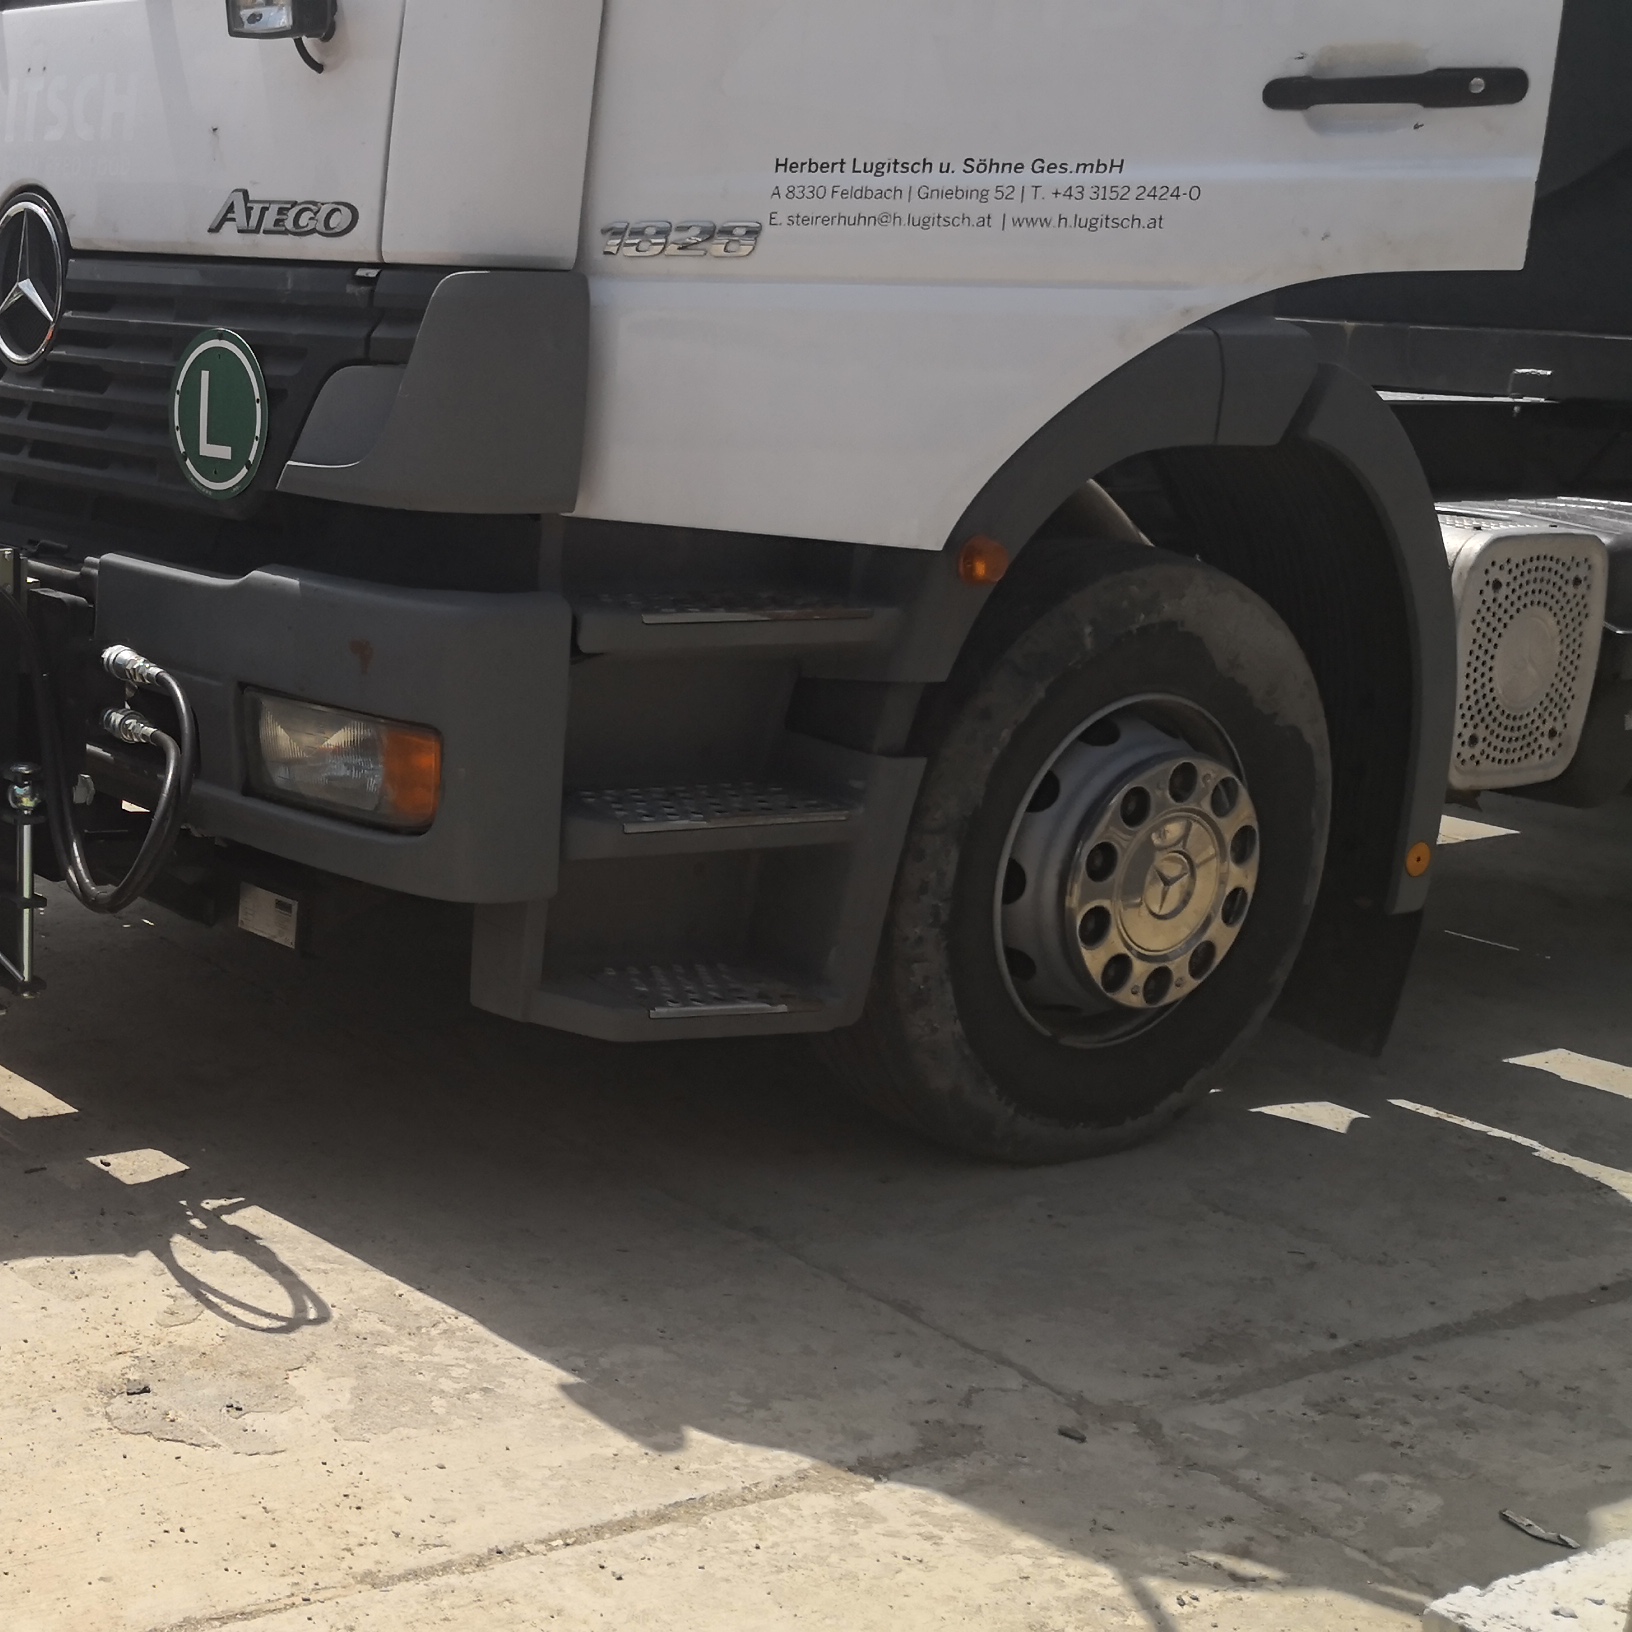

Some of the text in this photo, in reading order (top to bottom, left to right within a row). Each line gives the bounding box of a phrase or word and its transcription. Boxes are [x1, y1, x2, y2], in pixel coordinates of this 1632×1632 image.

[773, 156, 1125, 179] Herbert Lugitsch u. Söhne Ges.mbH
[770, 184, 783, 200] A
[785, 184, 827, 200] 8330
[831, 184, 904, 201] Feldbach
[916, 184, 991, 204] Gniebing
[992, 184, 1016, 201] 52
[1030, 185, 1046, 201] T.
[1050, 185, 1086, 202] +43
[1088, 184, 1132, 202] 3152
[1134, 184, 1202, 202] 2424-0
[207, 187, 359, 238] ATEGO
[768, 211, 783, 227] E.
[786, 211, 993, 231] steirerhuhn@h.lugitsch.at
[1011, 212, 1165, 233] www.h.lugitsch.at
[599, 219, 763, 259] 1828
[198, 369, 233, 461] L
